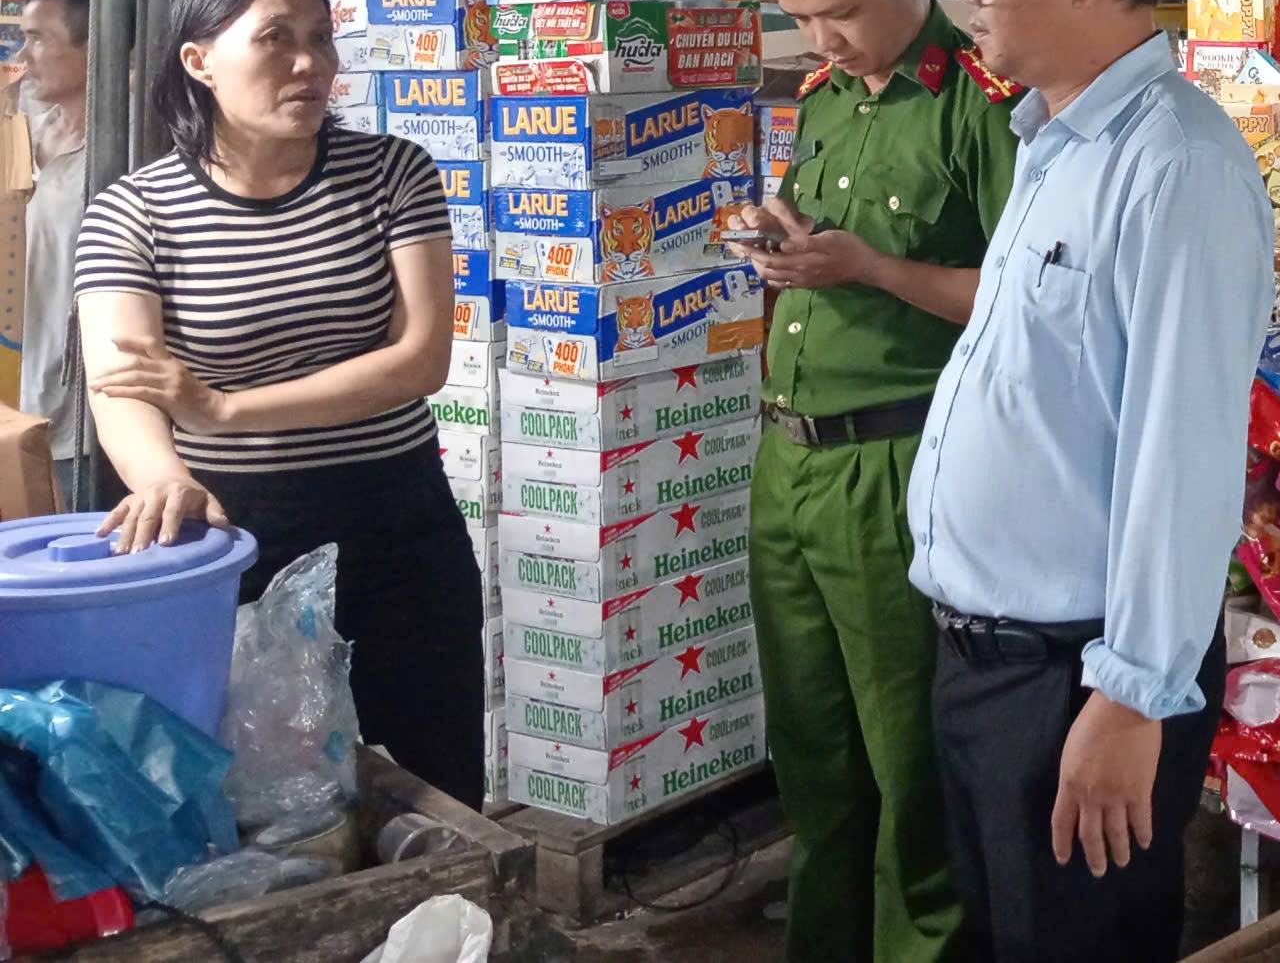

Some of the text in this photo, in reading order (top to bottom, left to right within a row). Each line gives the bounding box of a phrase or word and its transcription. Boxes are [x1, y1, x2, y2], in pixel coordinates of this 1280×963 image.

[391, 9, 428, 21] SMOOTH
[494, 13, 528, 30] huda
[416, 32, 438, 51] 400
[615, 38, 662, 59] huda
[718, 33, 732, 47] DU
[394, 79, 466, 105] LARUE
[403, 119, 456, 135] SMOOTH
[502, 106, 577, 135] LARUE
[629, 101, 701, 146] LARUE
[507, 146, 563, 162] SMOOTH
[642, 144, 694, 171] SMOOTH
[508, 193, 569, 217] LARUE
[654, 190, 712, 229] LARUE
[519, 218, 559, 230] SMOOTH
[660, 228, 703, 254] SMOOTH
[547, 245, 573, 266] 400
[545, 265, 569, 277] IPHONE
[523, 288, 580, 314] LARUE
[659, 282, 723, 326] LARUE
[531, 315, 572, 328] SMOOTH
[670, 319, 715, 350] SMOOTH
[553, 344, 579, 363] 400
[553, 362, 576, 375] IPHONE
[703, 361, 745, 385] COOLPACK
[431, 400, 488, 426] neken
[655, 393, 751, 432] Heineken
[520, 411, 578, 441] COOLPACK
[704, 435, 747, 457] COOLPACK
[656, 463, 752, 504] Heineken
[521, 483, 578, 514] COOLPACK
[701, 504, 743, 528] COOLPACK
[654, 535, 749, 579] Heineken
[518, 553, 577, 589] COOLPACK
[704, 573, 747, 597] COOLPACK
[658, 602, 752, 647] Heineken
[524, 630, 583, 663] COOLPACK
[706, 645, 748, 669] COOLPACK
[659, 672, 754, 721] Heineken
[525, 704, 583, 738] COOLPACK
[709, 716, 750, 740] COOLPACK
[662, 744, 755, 796] Heineken
[528, 773, 587, 807] COOLPACK
